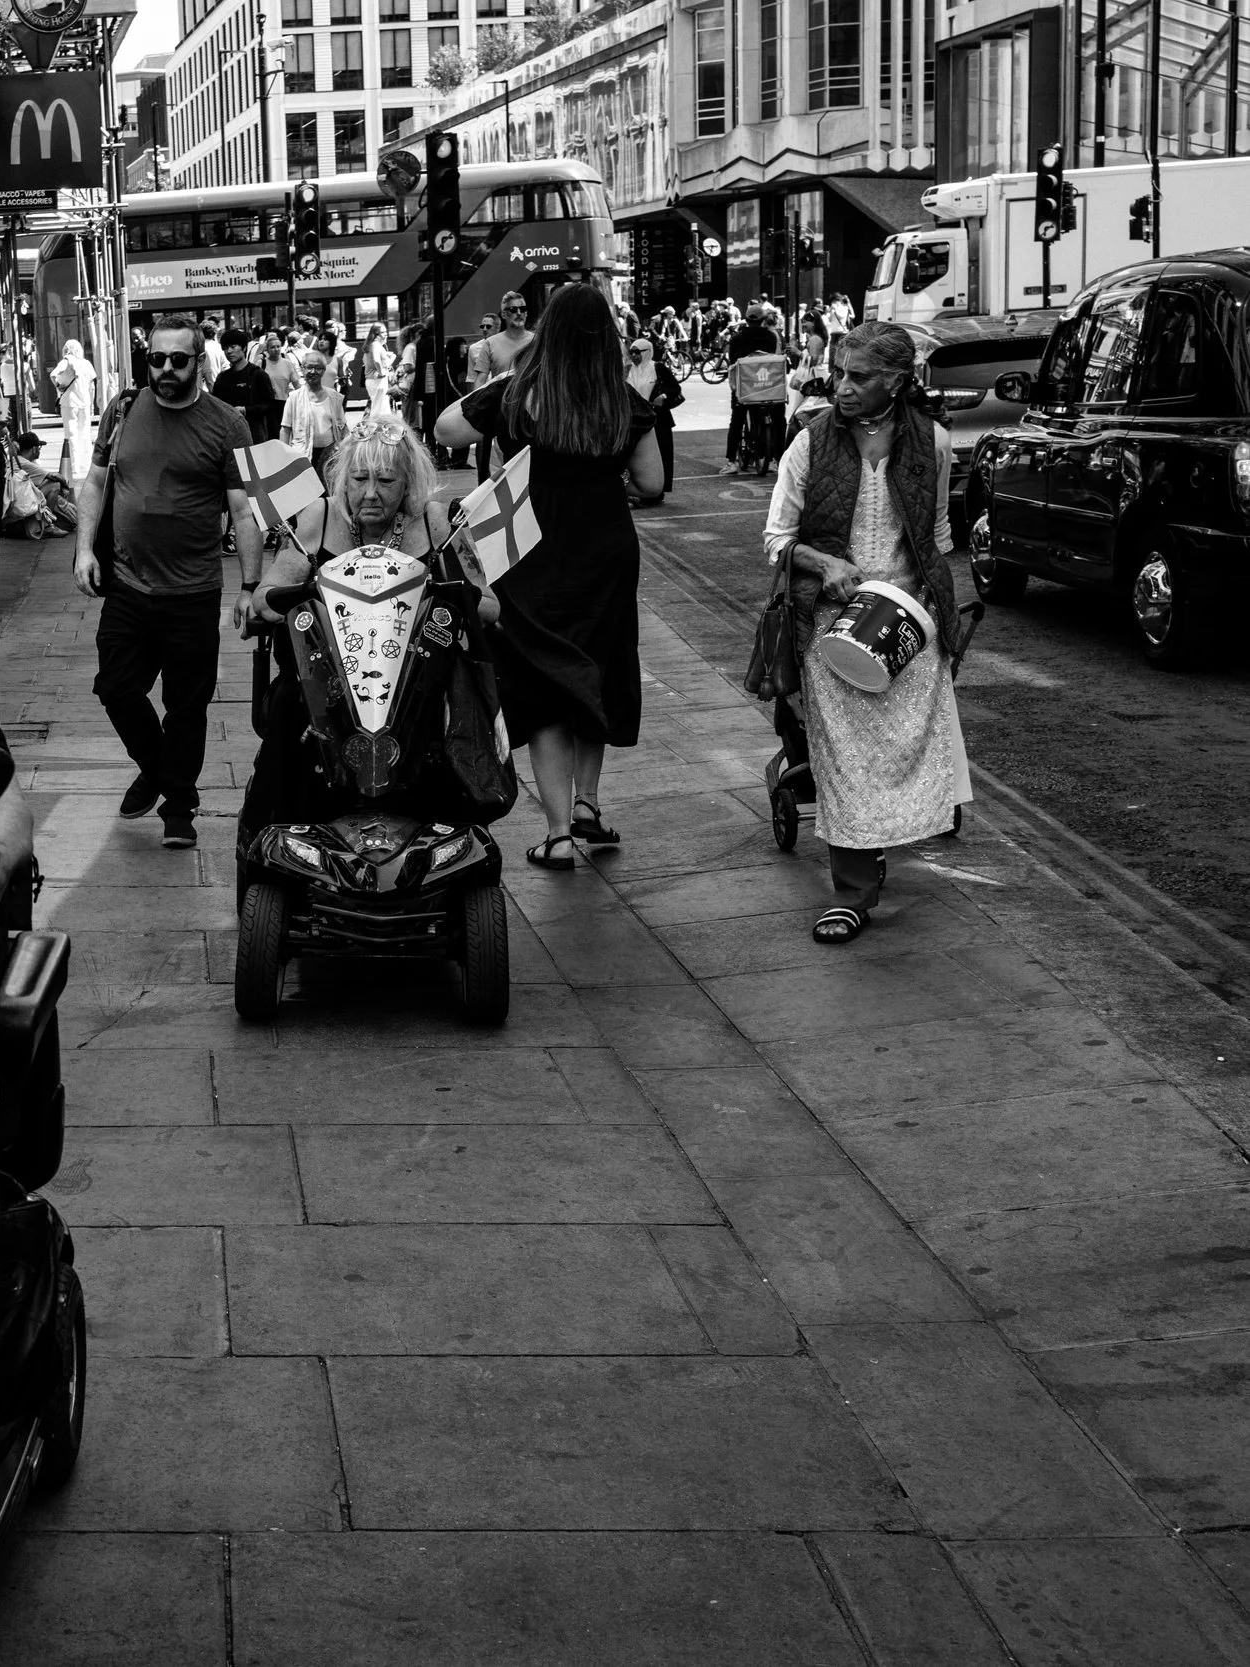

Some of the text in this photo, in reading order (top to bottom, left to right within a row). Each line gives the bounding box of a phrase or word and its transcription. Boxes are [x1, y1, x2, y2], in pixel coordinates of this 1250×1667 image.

[52, 7, 77, 26] HORSE
[24, 189, 46, 197] VAPES
[7, 197, 52, 206] ACCESSORIES
[524, 245, 560, 257] arriva
[184, 266, 224, 278] Banksy,
[641, 230, 649, 306] FOOD HALL
[130, 273, 173, 288] Moco
[185, 279, 228, 290] Kusama,
[229, 276, 256, 286] Hirst,
[323, 269, 355, 280] More!
